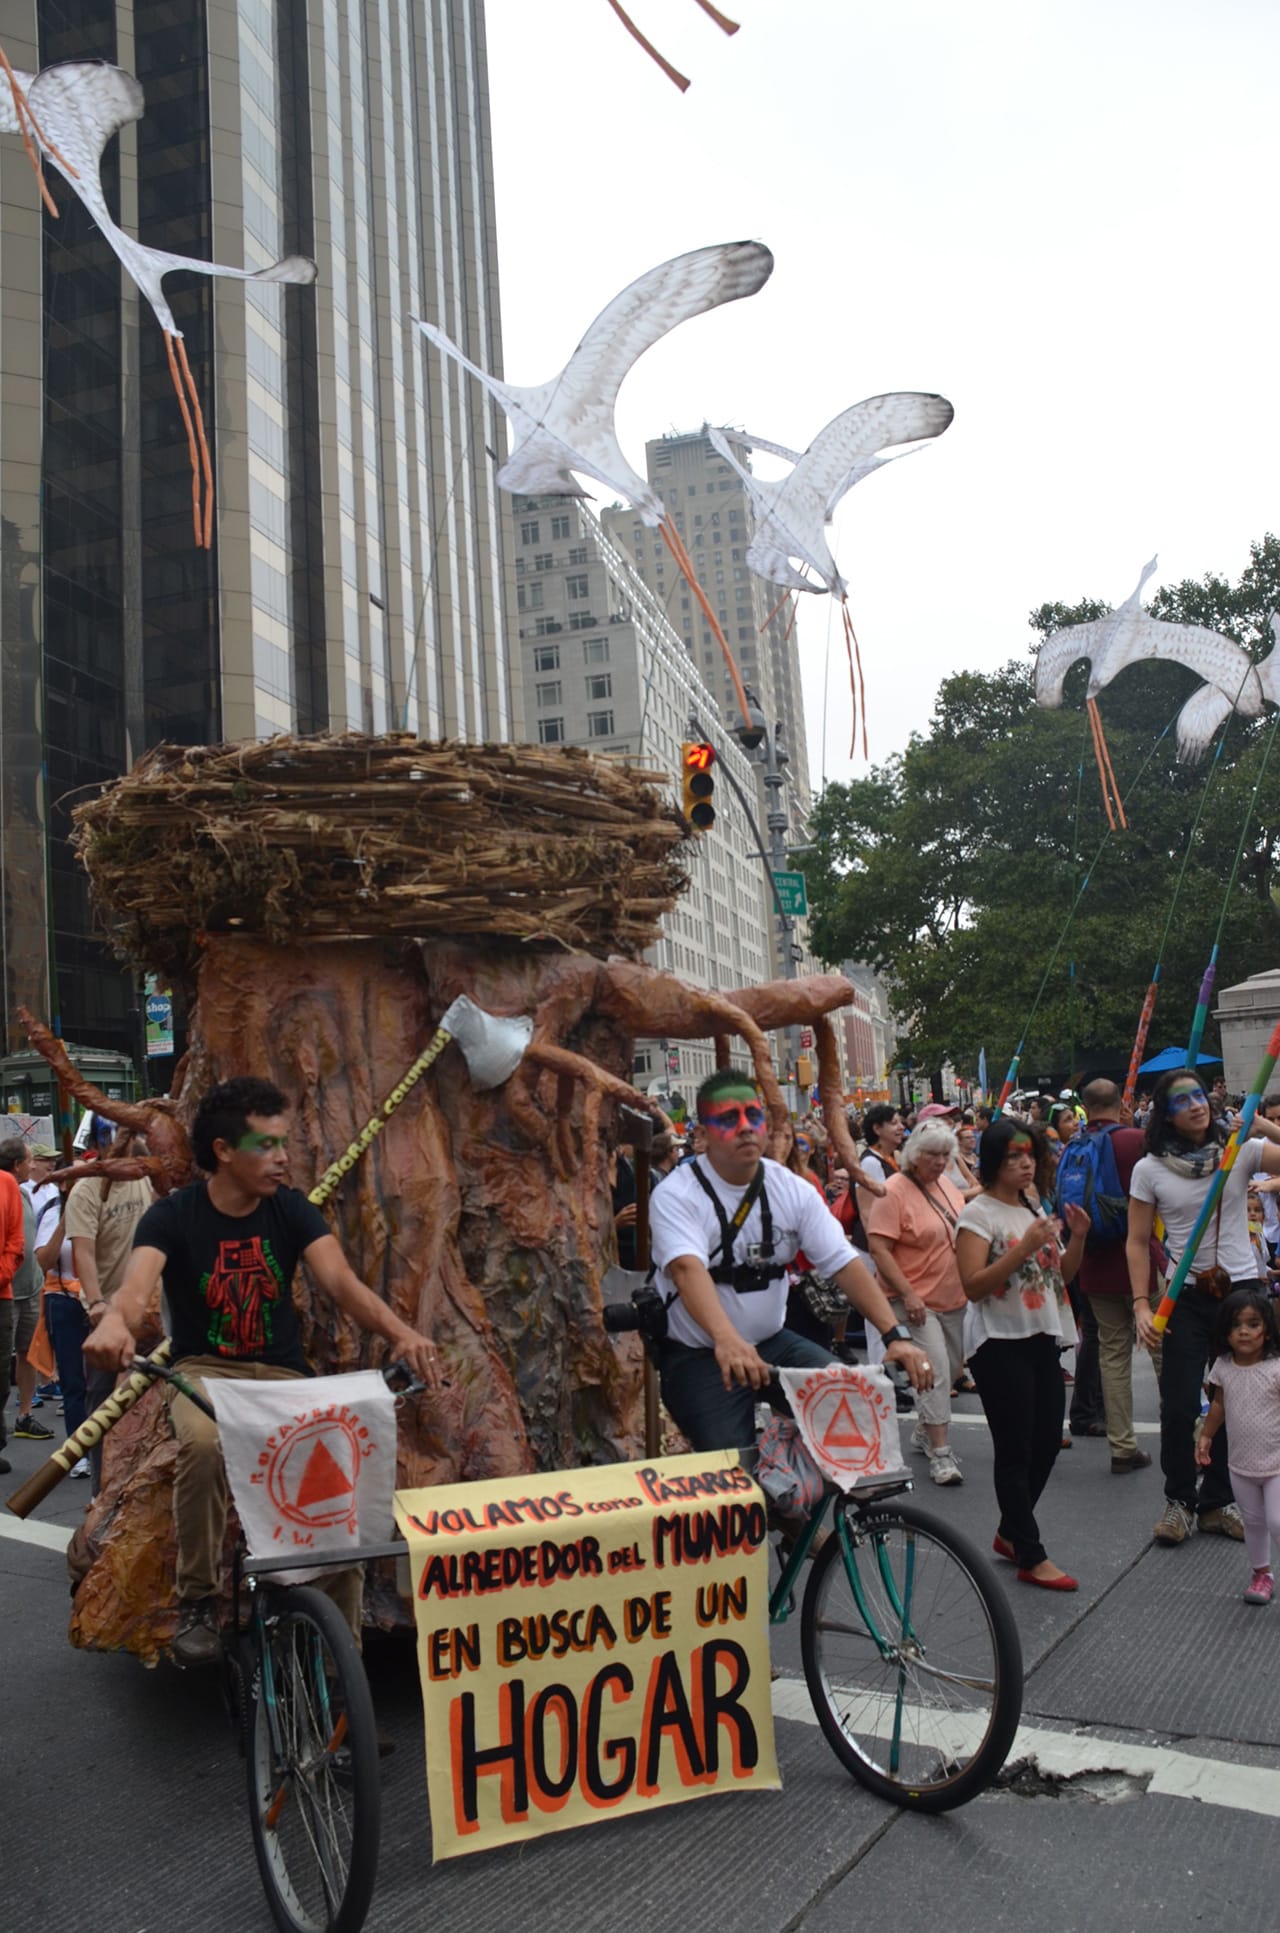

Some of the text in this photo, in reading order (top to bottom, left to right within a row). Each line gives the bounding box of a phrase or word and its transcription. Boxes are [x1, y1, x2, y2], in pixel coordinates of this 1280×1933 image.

[775, 877, 800, 888] CENTRAL
[384, 1028, 452, 1115] COLUMBUS
[50, 1336, 174, 1473] MONSAT
[407, 1491, 583, 1536] VOLAMOS
[418, 1502, 768, 1600] ALREDEDOR DEL MUNDO
[428, 1576, 747, 1681] EN BUSCA DE UN
[449, 1637, 759, 1837] HOGAR
